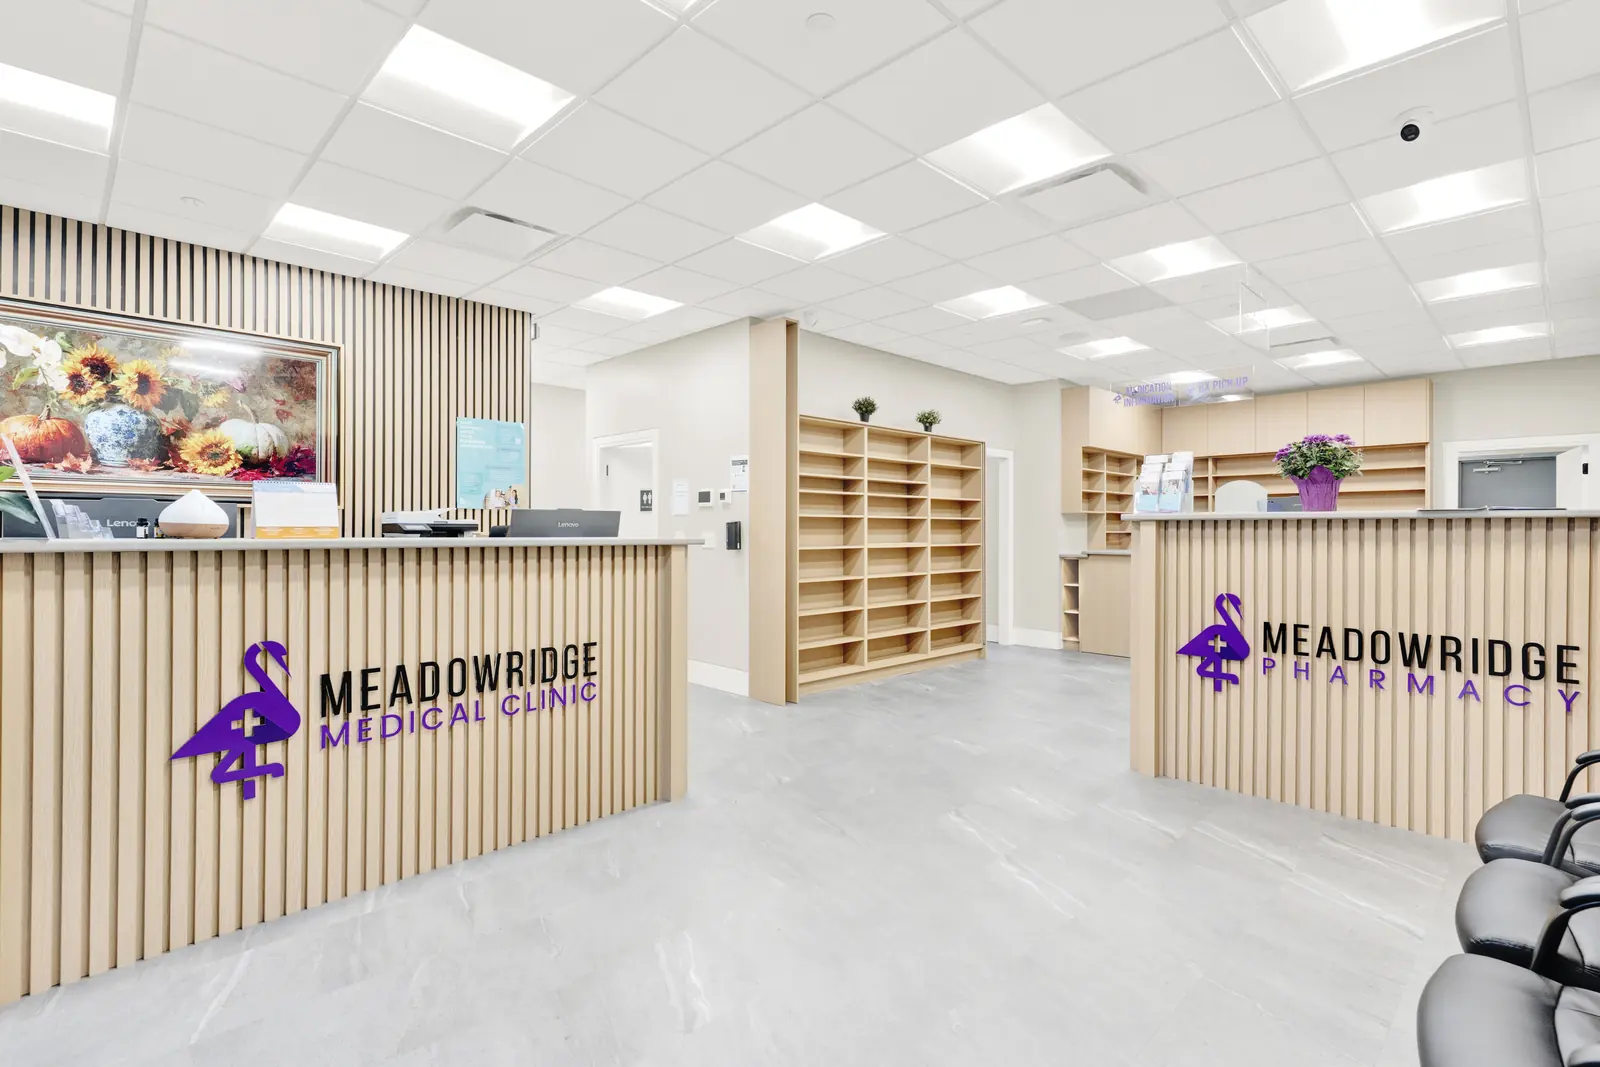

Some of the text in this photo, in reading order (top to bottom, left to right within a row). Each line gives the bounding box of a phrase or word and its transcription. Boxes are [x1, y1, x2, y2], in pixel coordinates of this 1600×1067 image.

[1212, 379, 1233, 391] PICK
[1236, 376, 1248, 388] UP
[106, 519, 151, 527] Leno
[319, 641, 598, 718] MEADOWRIDGE
[1262, 621, 1581, 685] MEADOWRIDGE
[1261, 656, 1581, 713] PHARMACY
[319, 681, 598, 750] MEDICAL CLINIC
